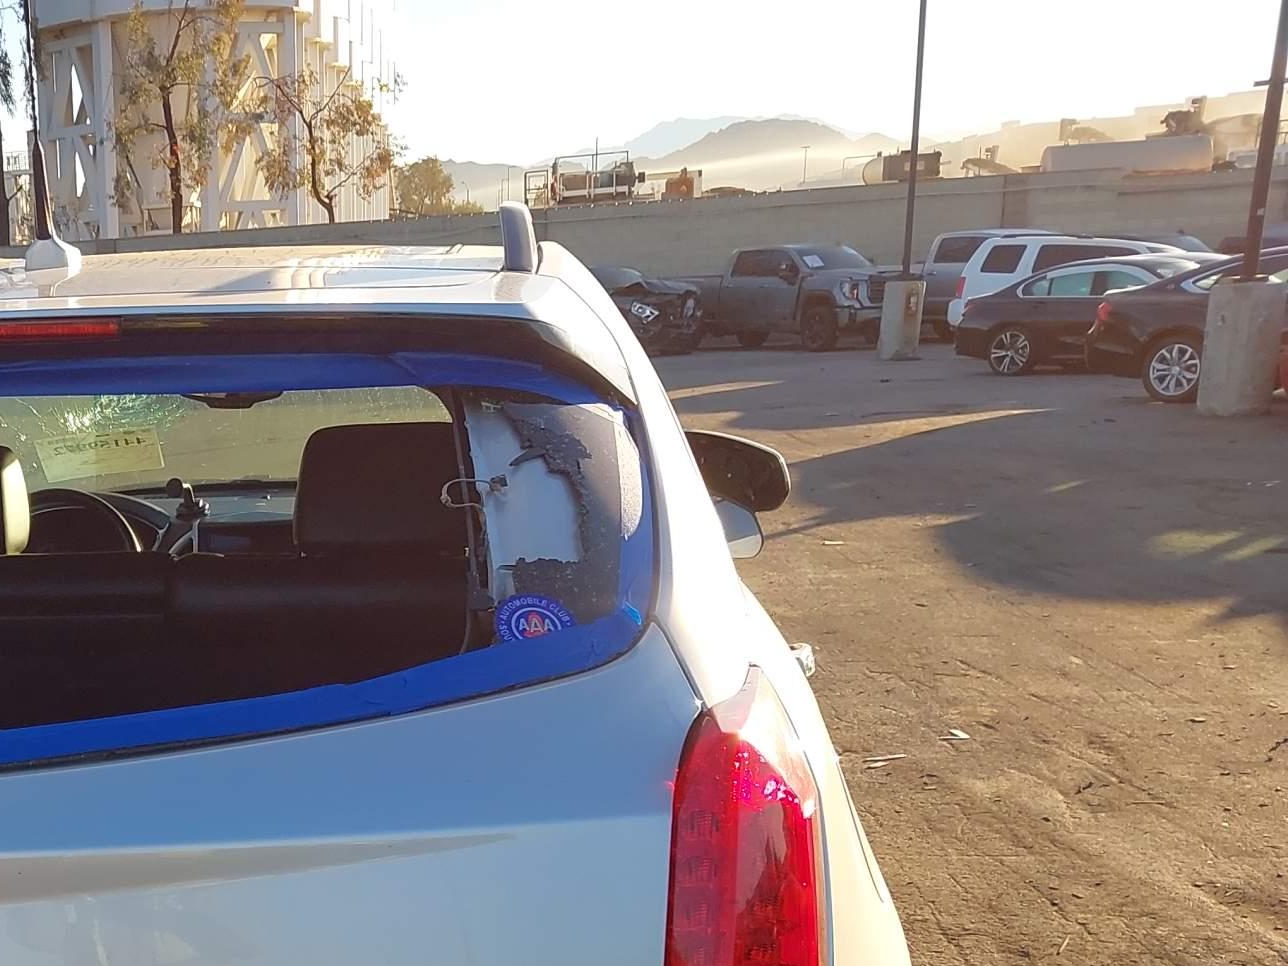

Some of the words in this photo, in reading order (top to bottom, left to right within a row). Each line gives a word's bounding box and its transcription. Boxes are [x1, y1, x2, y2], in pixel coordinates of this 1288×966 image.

[501, 597, 548, 620] AUTOMOBILE
[549, 603, 570, 622] CLUB
[519, 618, 555, 633] AAA
